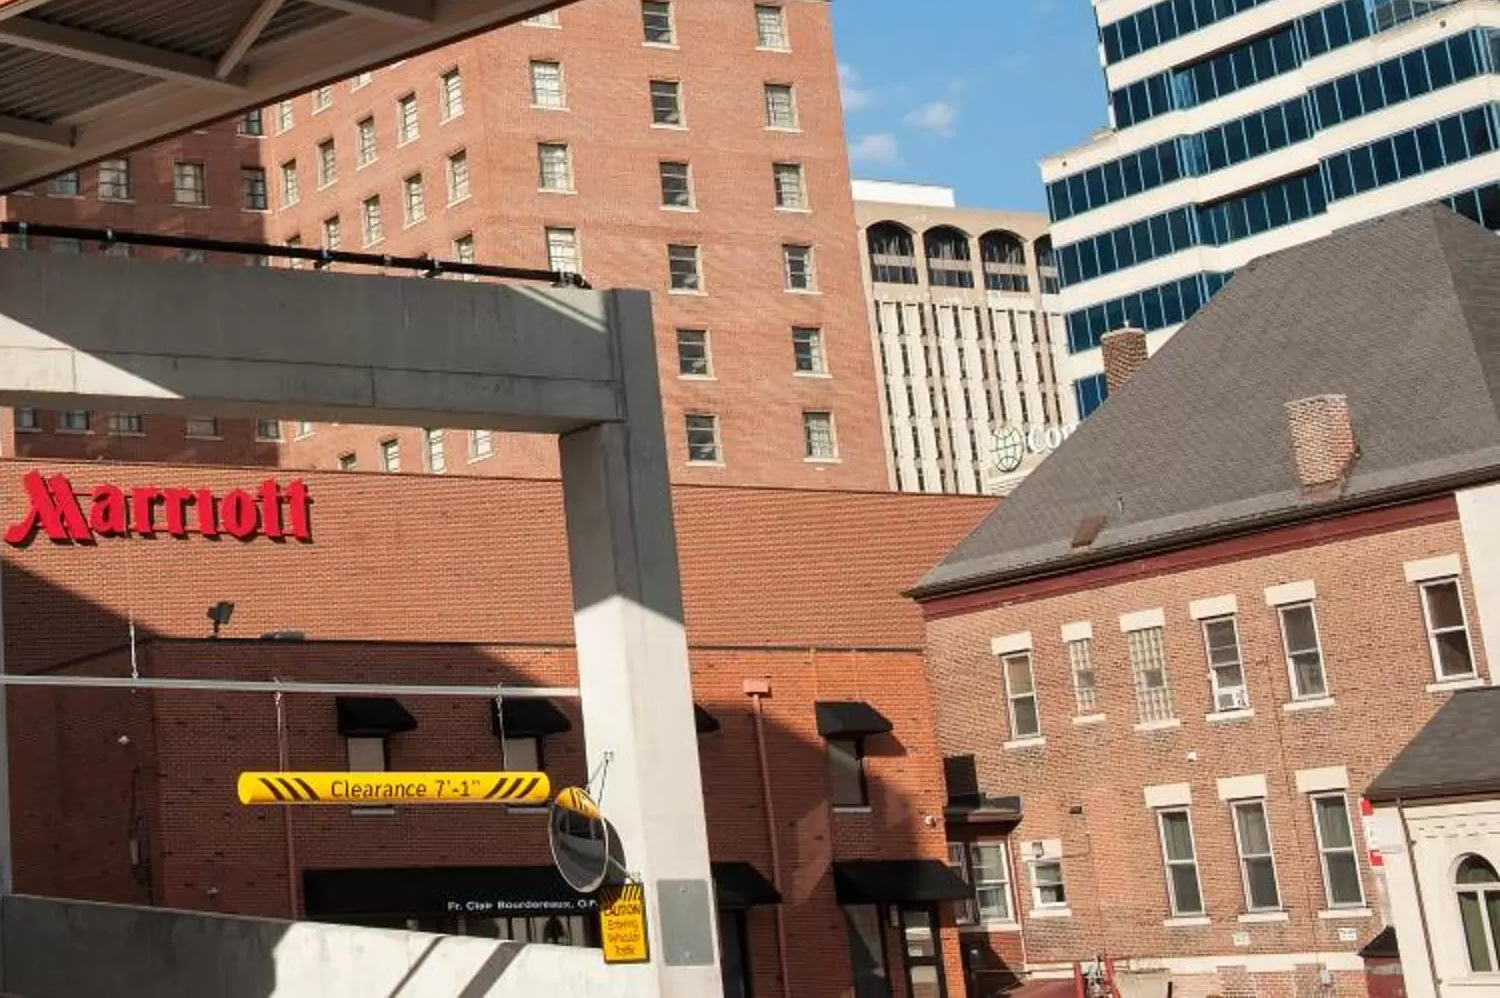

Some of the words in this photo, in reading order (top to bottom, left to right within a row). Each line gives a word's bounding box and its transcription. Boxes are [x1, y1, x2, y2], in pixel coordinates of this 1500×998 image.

[4, 469, 311, 545] Marriott
[331, 779, 427, 798] Clearance
[603, 903, 642, 917] CAUTION
